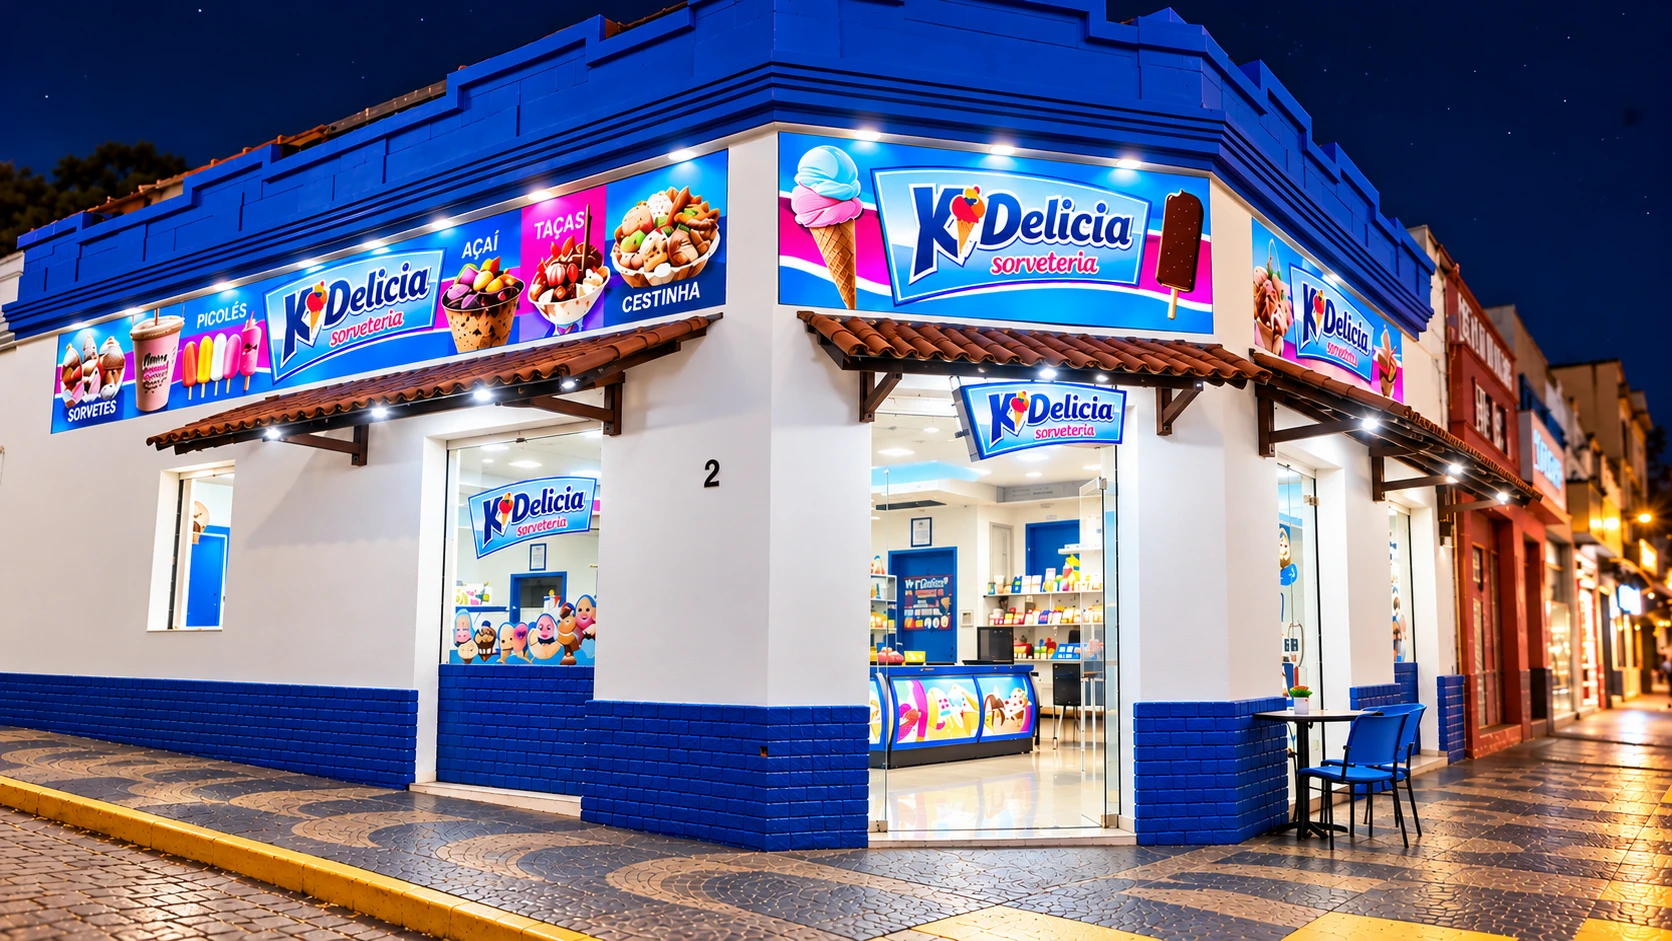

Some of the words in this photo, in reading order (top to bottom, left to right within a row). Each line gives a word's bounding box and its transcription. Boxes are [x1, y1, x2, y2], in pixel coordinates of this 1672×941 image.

[534, 211, 585, 240] TAÇAS
[461, 230, 500, 260] AÇAÍ
[990, 251, 1098, 276] sorveteria
[621, 281, 701, 313] CESTINHA
[196, 302, 247, 328] PICOLÉS
[330, 310, 403, 346] sorveteria
[67, 400, 117, 423] SORVETES
[1035, 424, 1095, 439] sorveteria
[704, 458, 720, 488] 2
[517, 516, 567, 537] sorveteria
